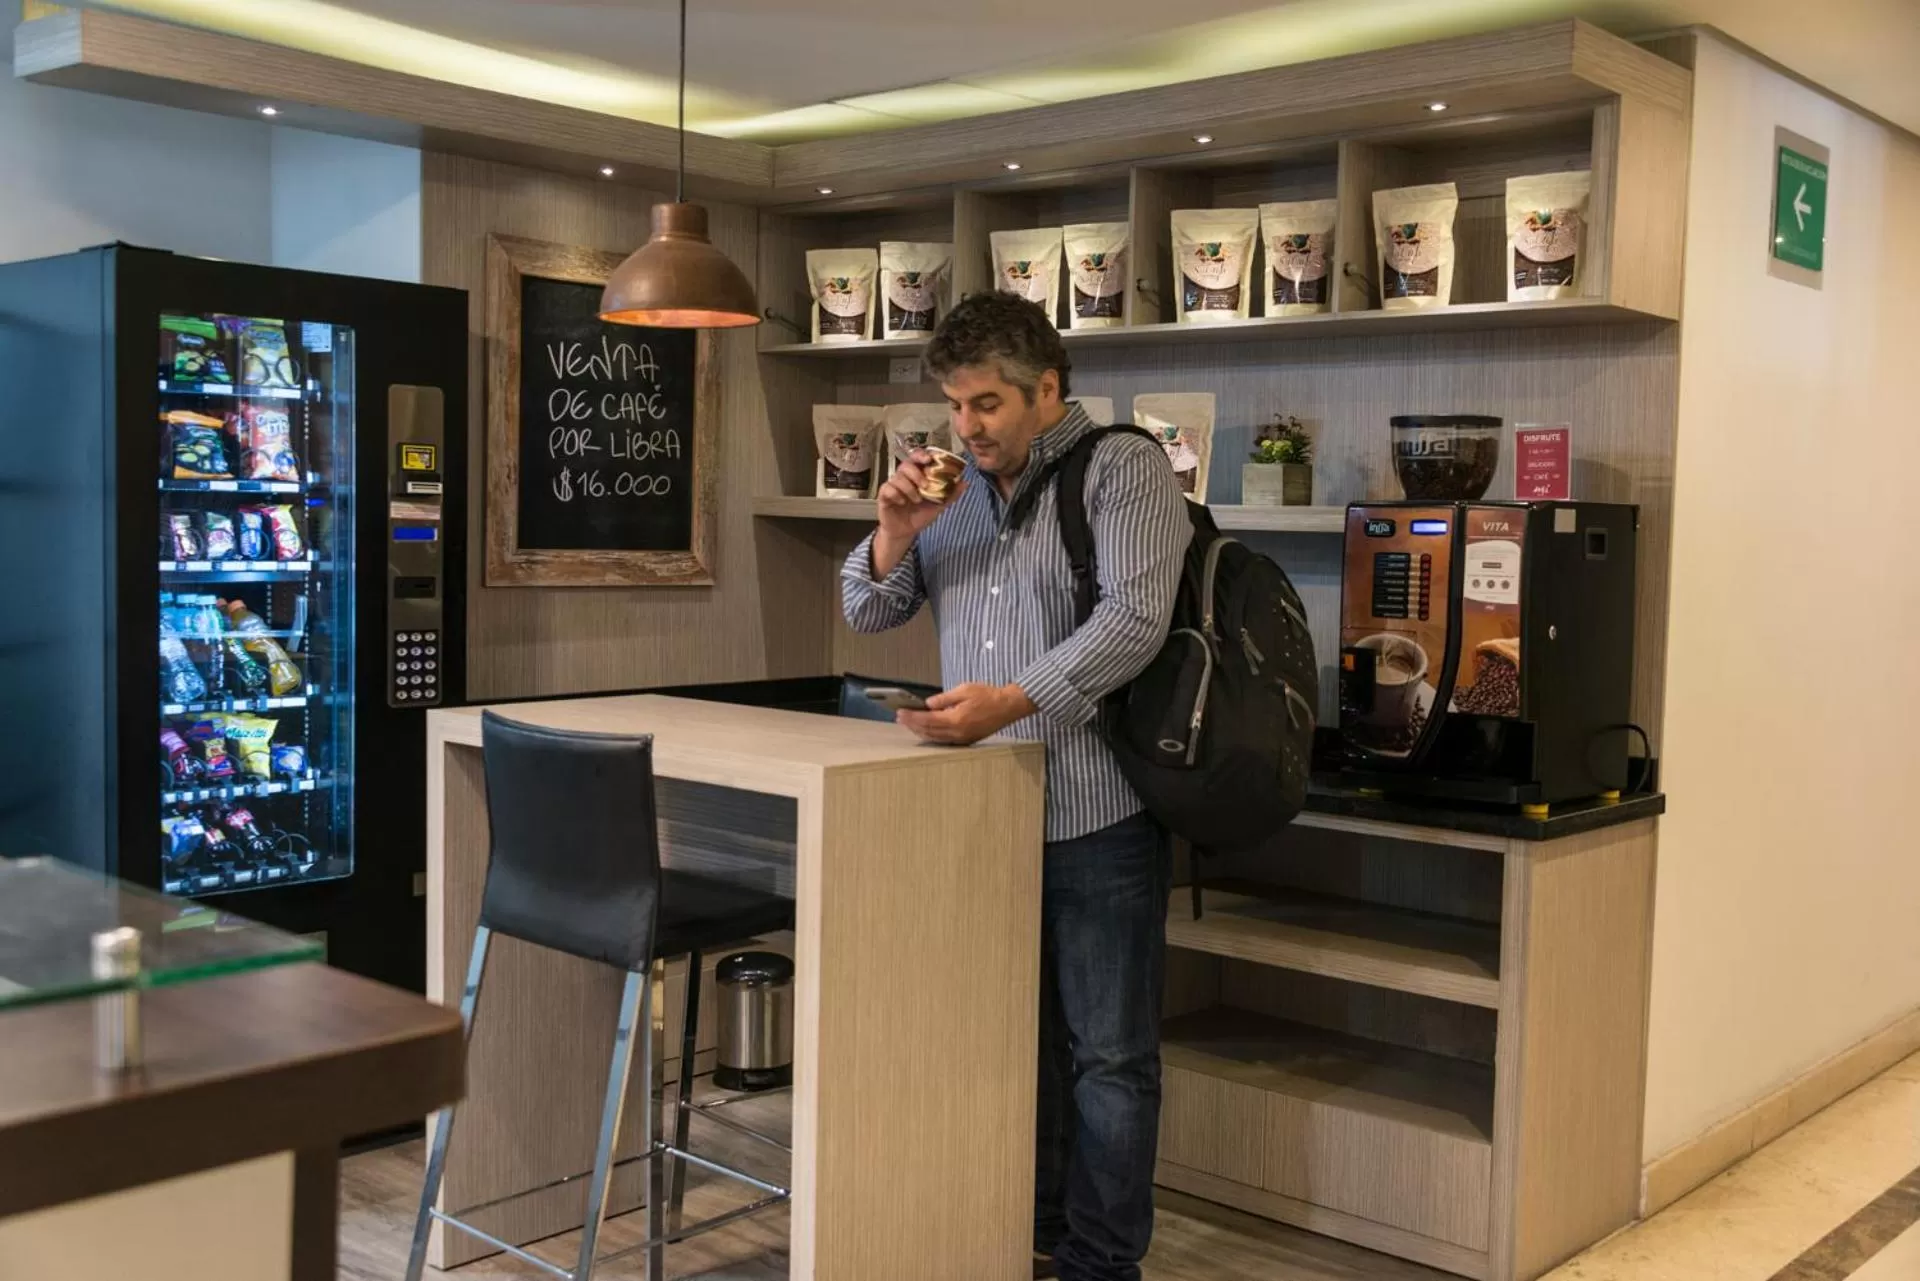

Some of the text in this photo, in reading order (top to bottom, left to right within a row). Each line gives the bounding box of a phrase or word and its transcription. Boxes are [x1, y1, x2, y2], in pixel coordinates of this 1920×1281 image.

[546, 334, 661, 382] VENTA
[548, 384, 667, 425] DE CAFÉ
[549, 426, 681, 461] POR LIBRA
[1523, 433, 1561, 443] DISFRUTE
[1482, 521, 1510, 533] VITA
